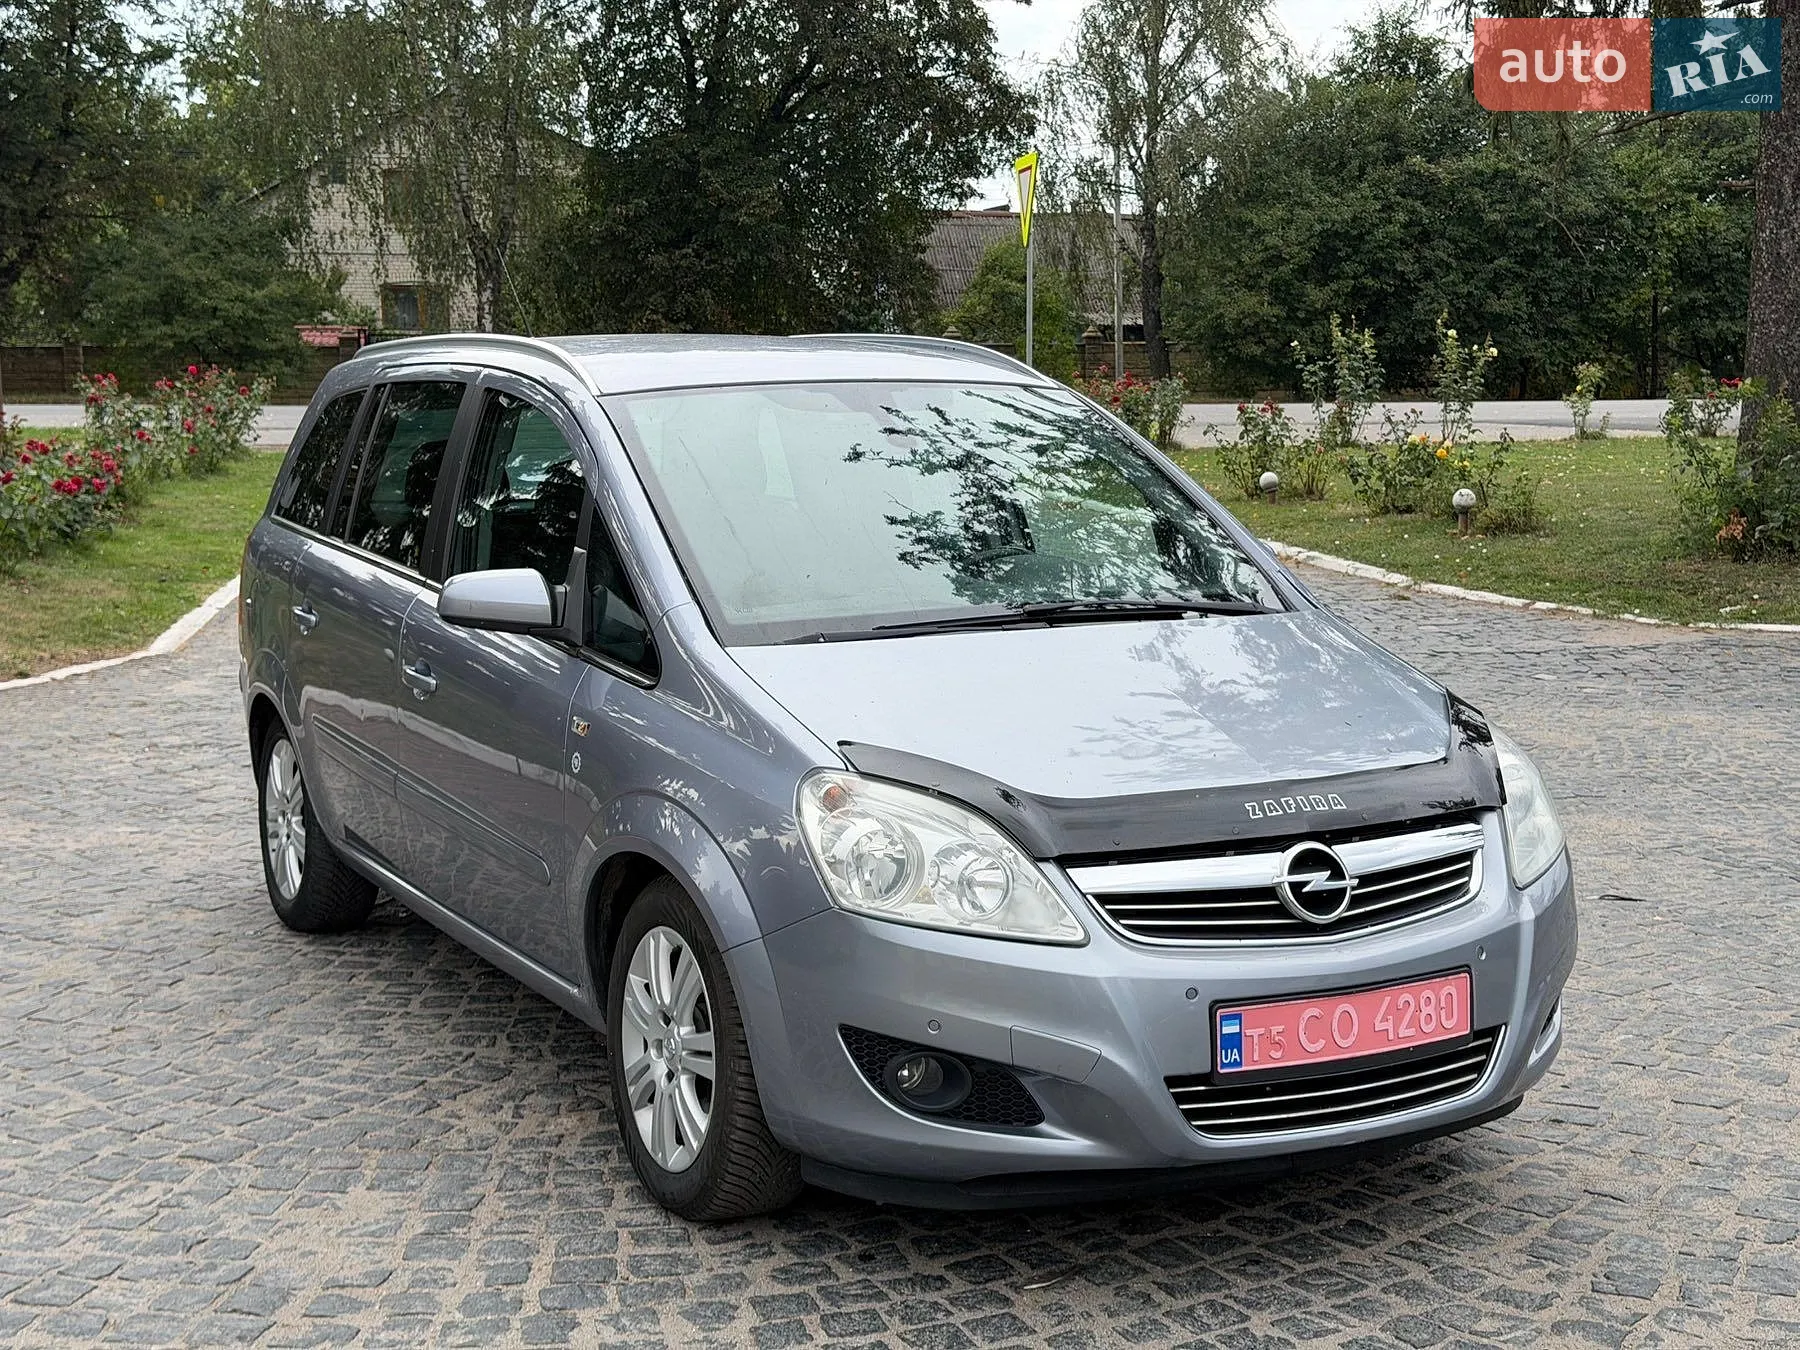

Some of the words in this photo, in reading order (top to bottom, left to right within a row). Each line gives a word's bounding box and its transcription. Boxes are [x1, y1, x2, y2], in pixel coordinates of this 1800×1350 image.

[1244, 793, 1347, 820] ZAFIRA
[1245, 1025, 1288, 1062] T5
[1298, 1003, 1359, 1054] CO
[1374, 985, 1458, 1041] 4280
[1222, 1049, 1240, 1064] UA
